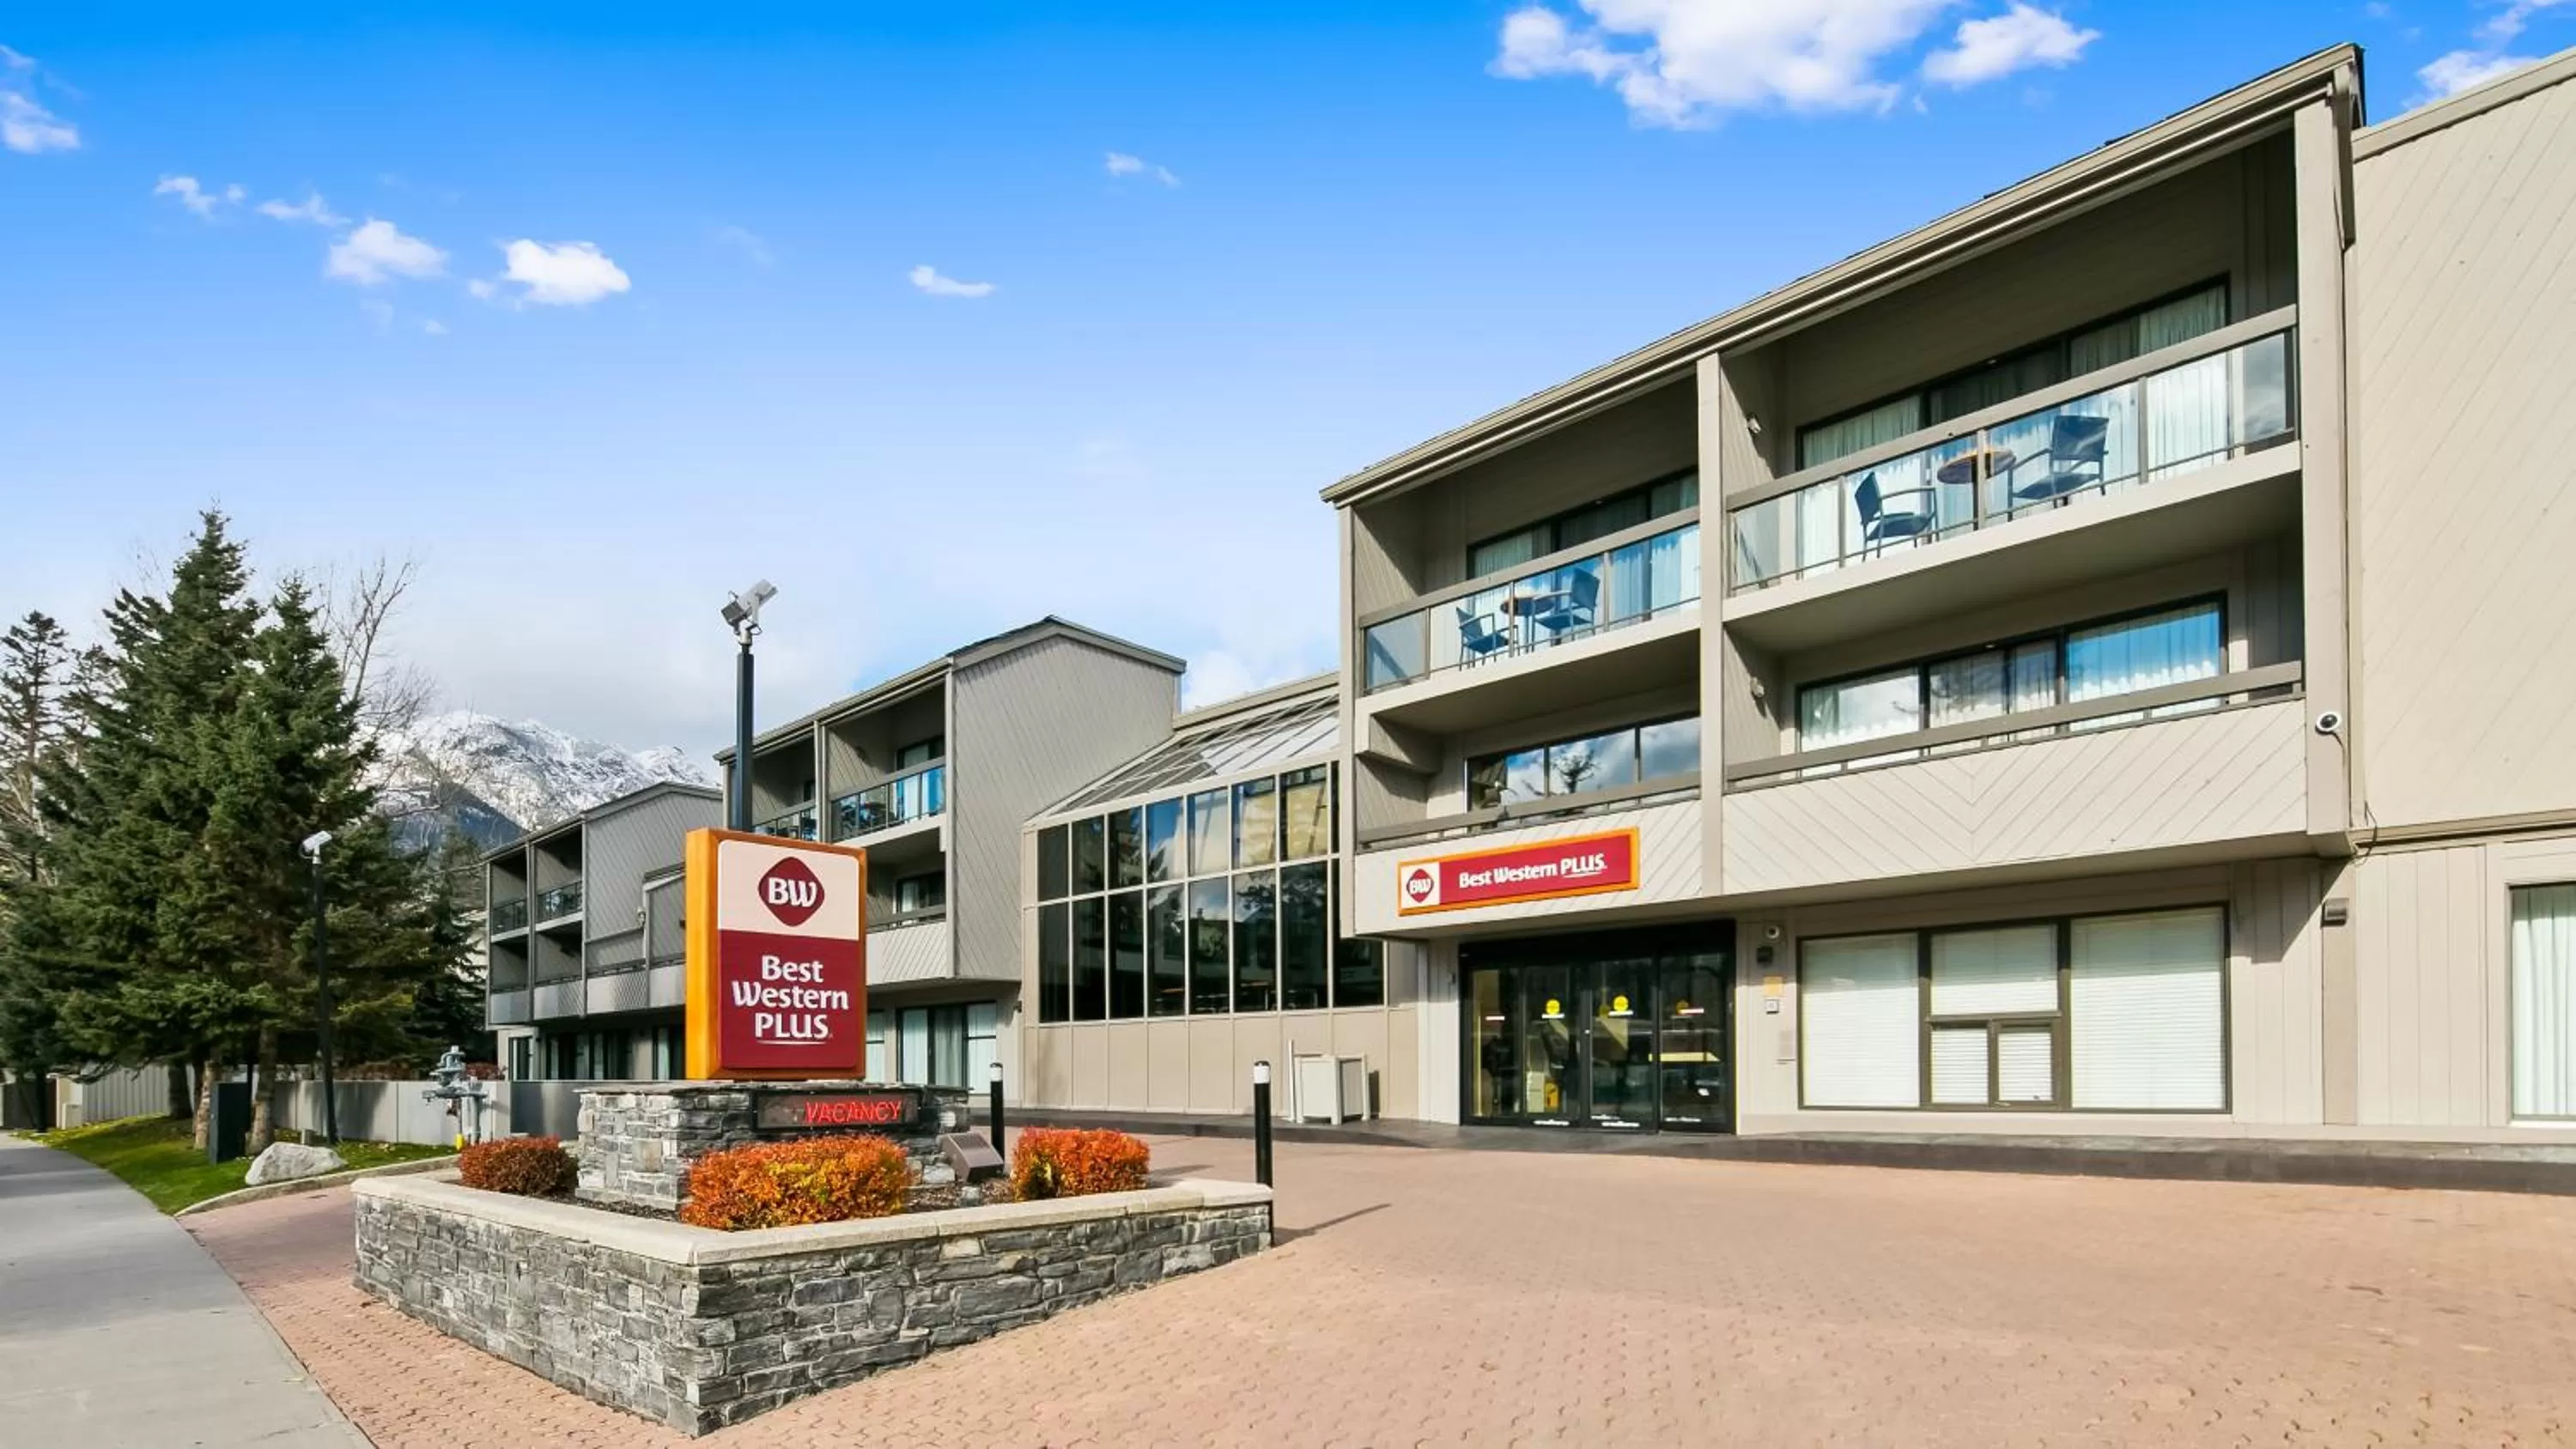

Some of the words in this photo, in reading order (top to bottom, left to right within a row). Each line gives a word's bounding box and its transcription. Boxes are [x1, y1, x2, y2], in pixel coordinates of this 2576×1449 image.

[1459, 871, 1493, 888] Best
[1494, 863, 1558, 883] Western
[1560, 853, 1605, 872] PLUS
[769, 877, 817, 908] BW
[1409, 878, 1431, 894] BW
[762, 955, 823, 983] Best
[732, 981, 849, 1010] Western
[755, 1013, 829, 1040] PLUS
[805, 1100, 901, 1124] VACANCY
